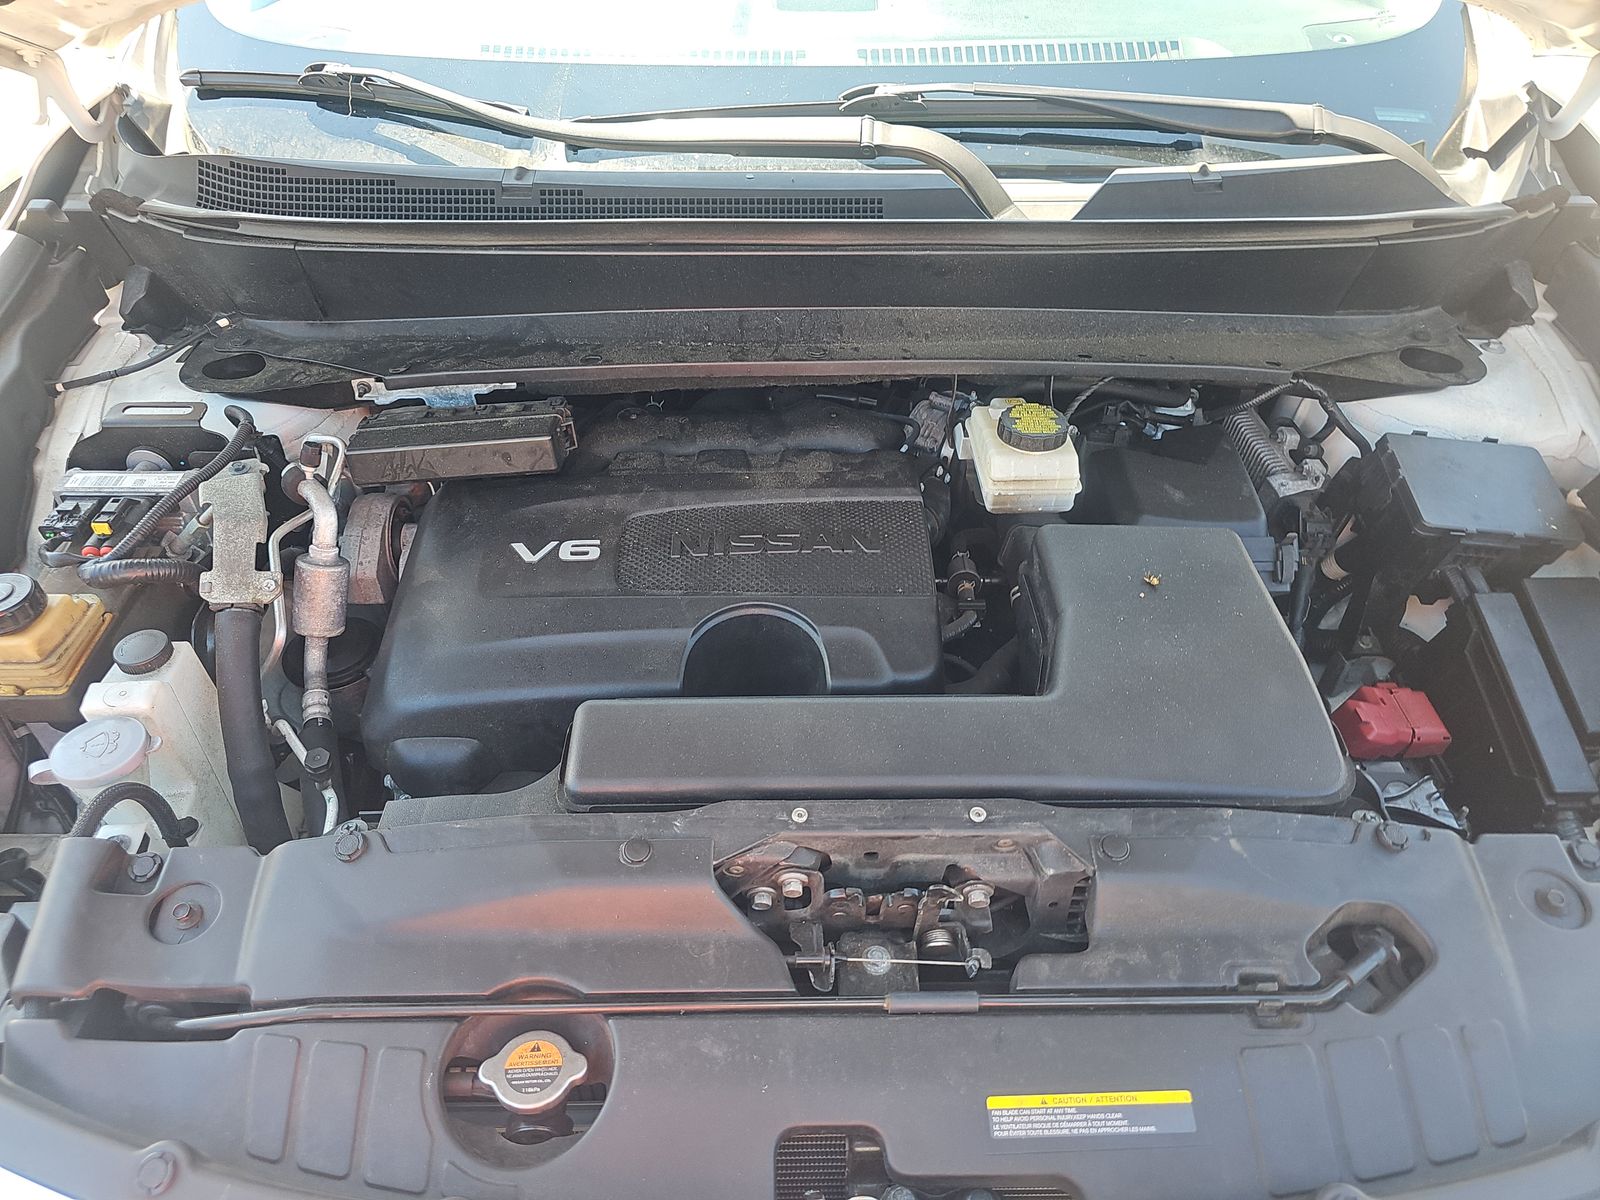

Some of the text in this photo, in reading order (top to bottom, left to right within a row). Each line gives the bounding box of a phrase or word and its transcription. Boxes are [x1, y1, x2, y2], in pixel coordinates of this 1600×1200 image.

[510, 539, 601, 563] V6
[671, 530, 881, 558] NISSAN
[509, 1059, 559, 1067] AVERTISSEMENT
[1095, 1095, 1138, 1103] ATTENTION
